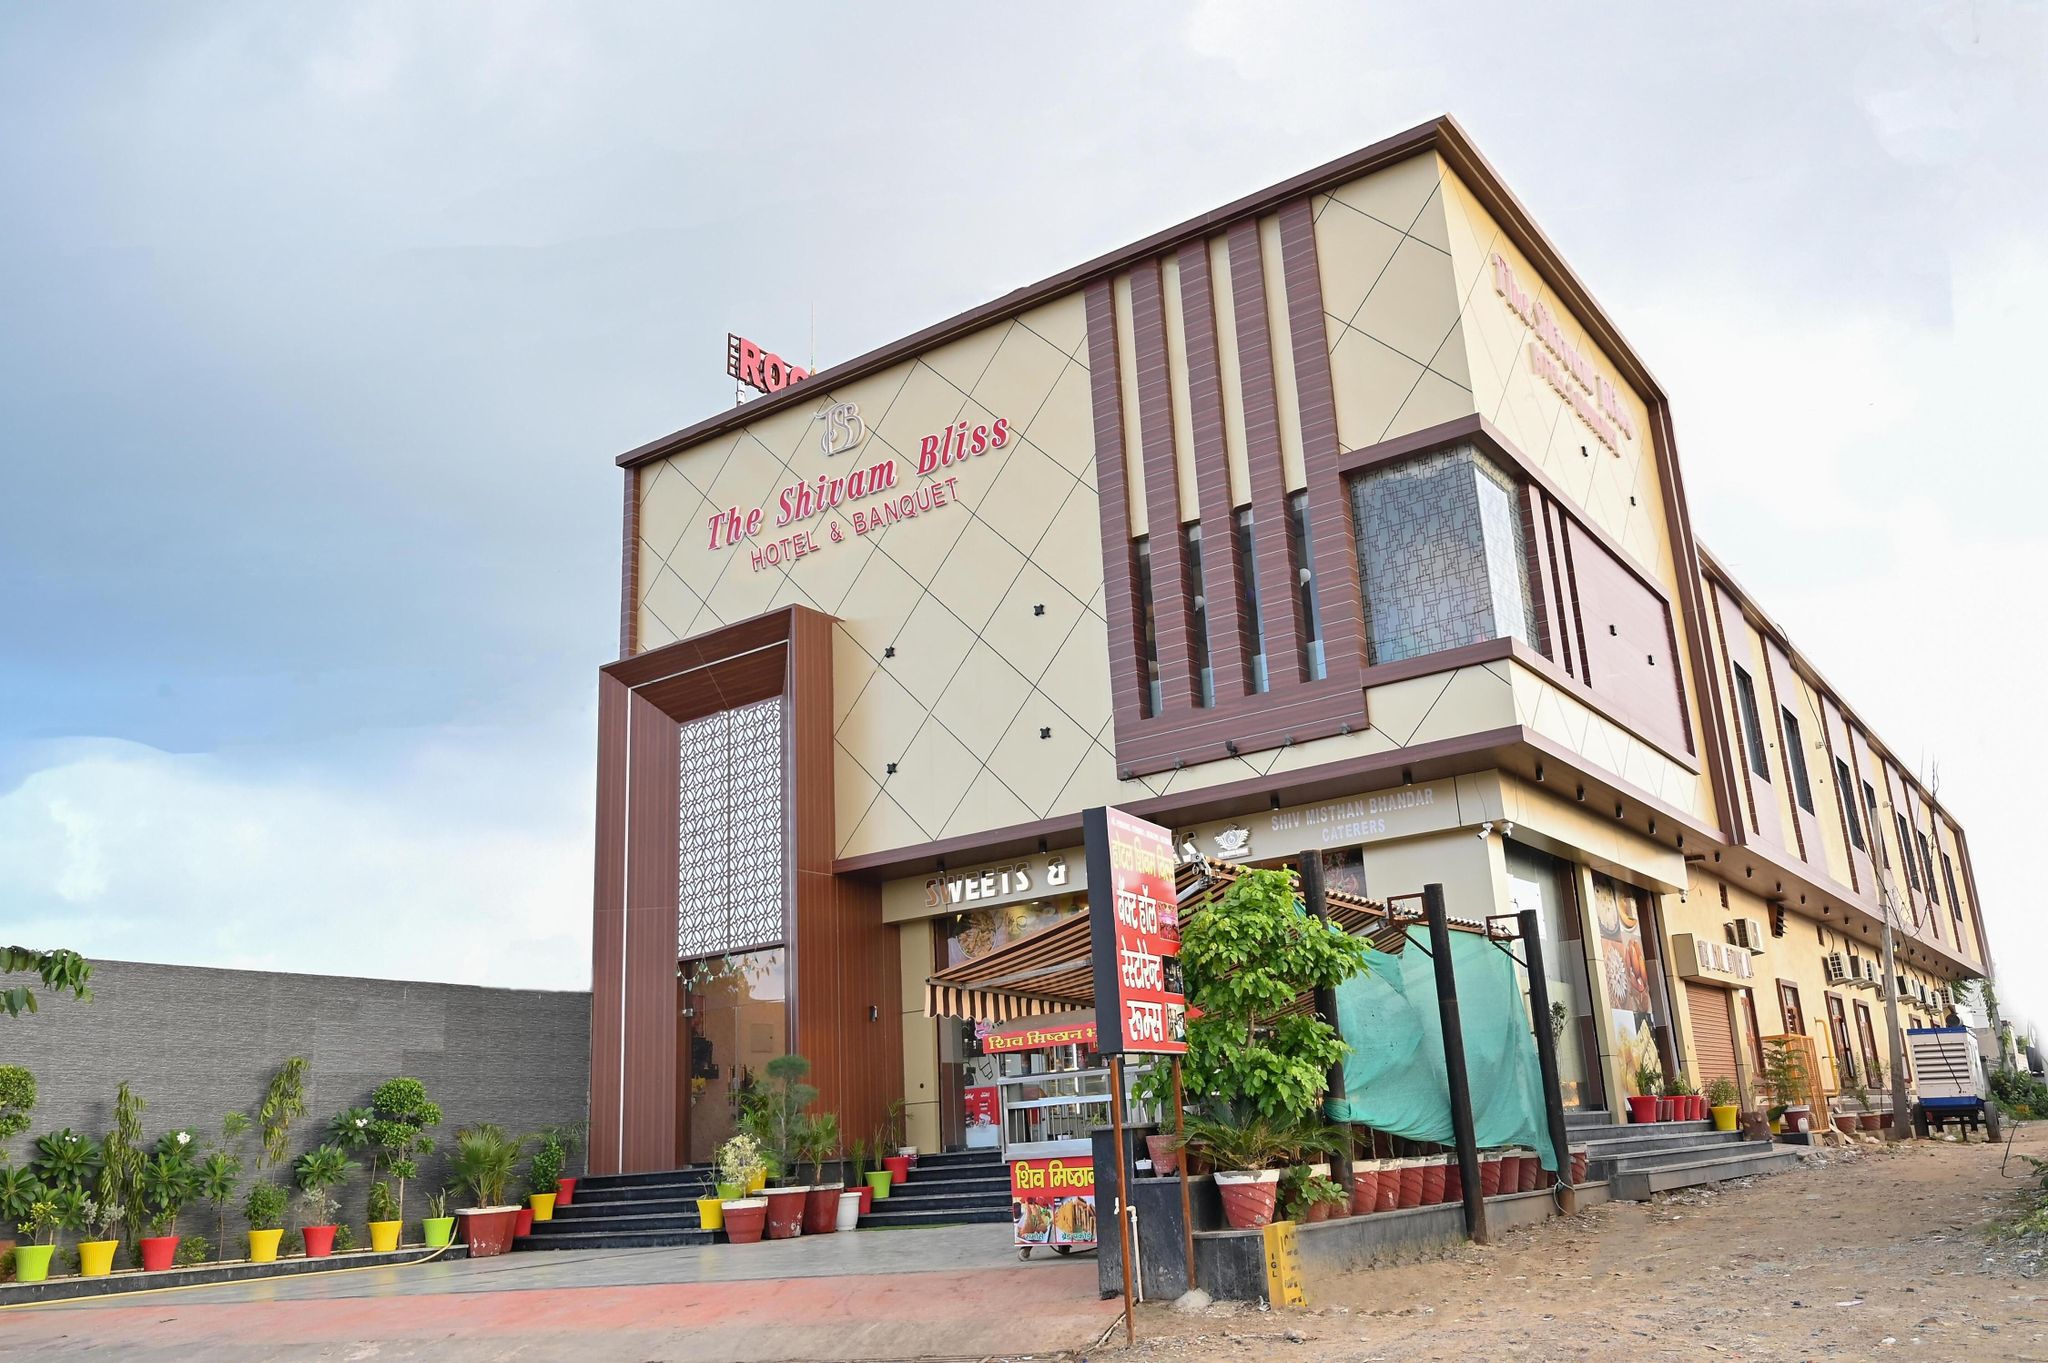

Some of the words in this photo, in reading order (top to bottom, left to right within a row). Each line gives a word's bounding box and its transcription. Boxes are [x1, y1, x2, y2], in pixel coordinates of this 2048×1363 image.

[706, 504, 764, 551] The
[775, 458, 899, 528] Shivam
[915, 416, 1012, 478] Bliss
[750, 529, 821, 572] HOTEL
[829, 520, 845, 543] &
[852, 476, 961, 537] BANQUET
[1271, 811, 1301, 831] SHIV
[1305, 801, 1364, 825] MISTHAN
[1369, 787, 1434, 814] BHANDAR
[1321, 818, 1386, 842] CATERERS
[924, 861, 1032, 908] SWEETS
[1046, 855, 1069, 886] &
[988, 1035, 1023, 1050] शिव
[1026, 1029, 1082, 1045] मिष्ठान
[1015, 1161, 1045, 1189] शिव
[1270, 1253, 1278, 1278] IGL
